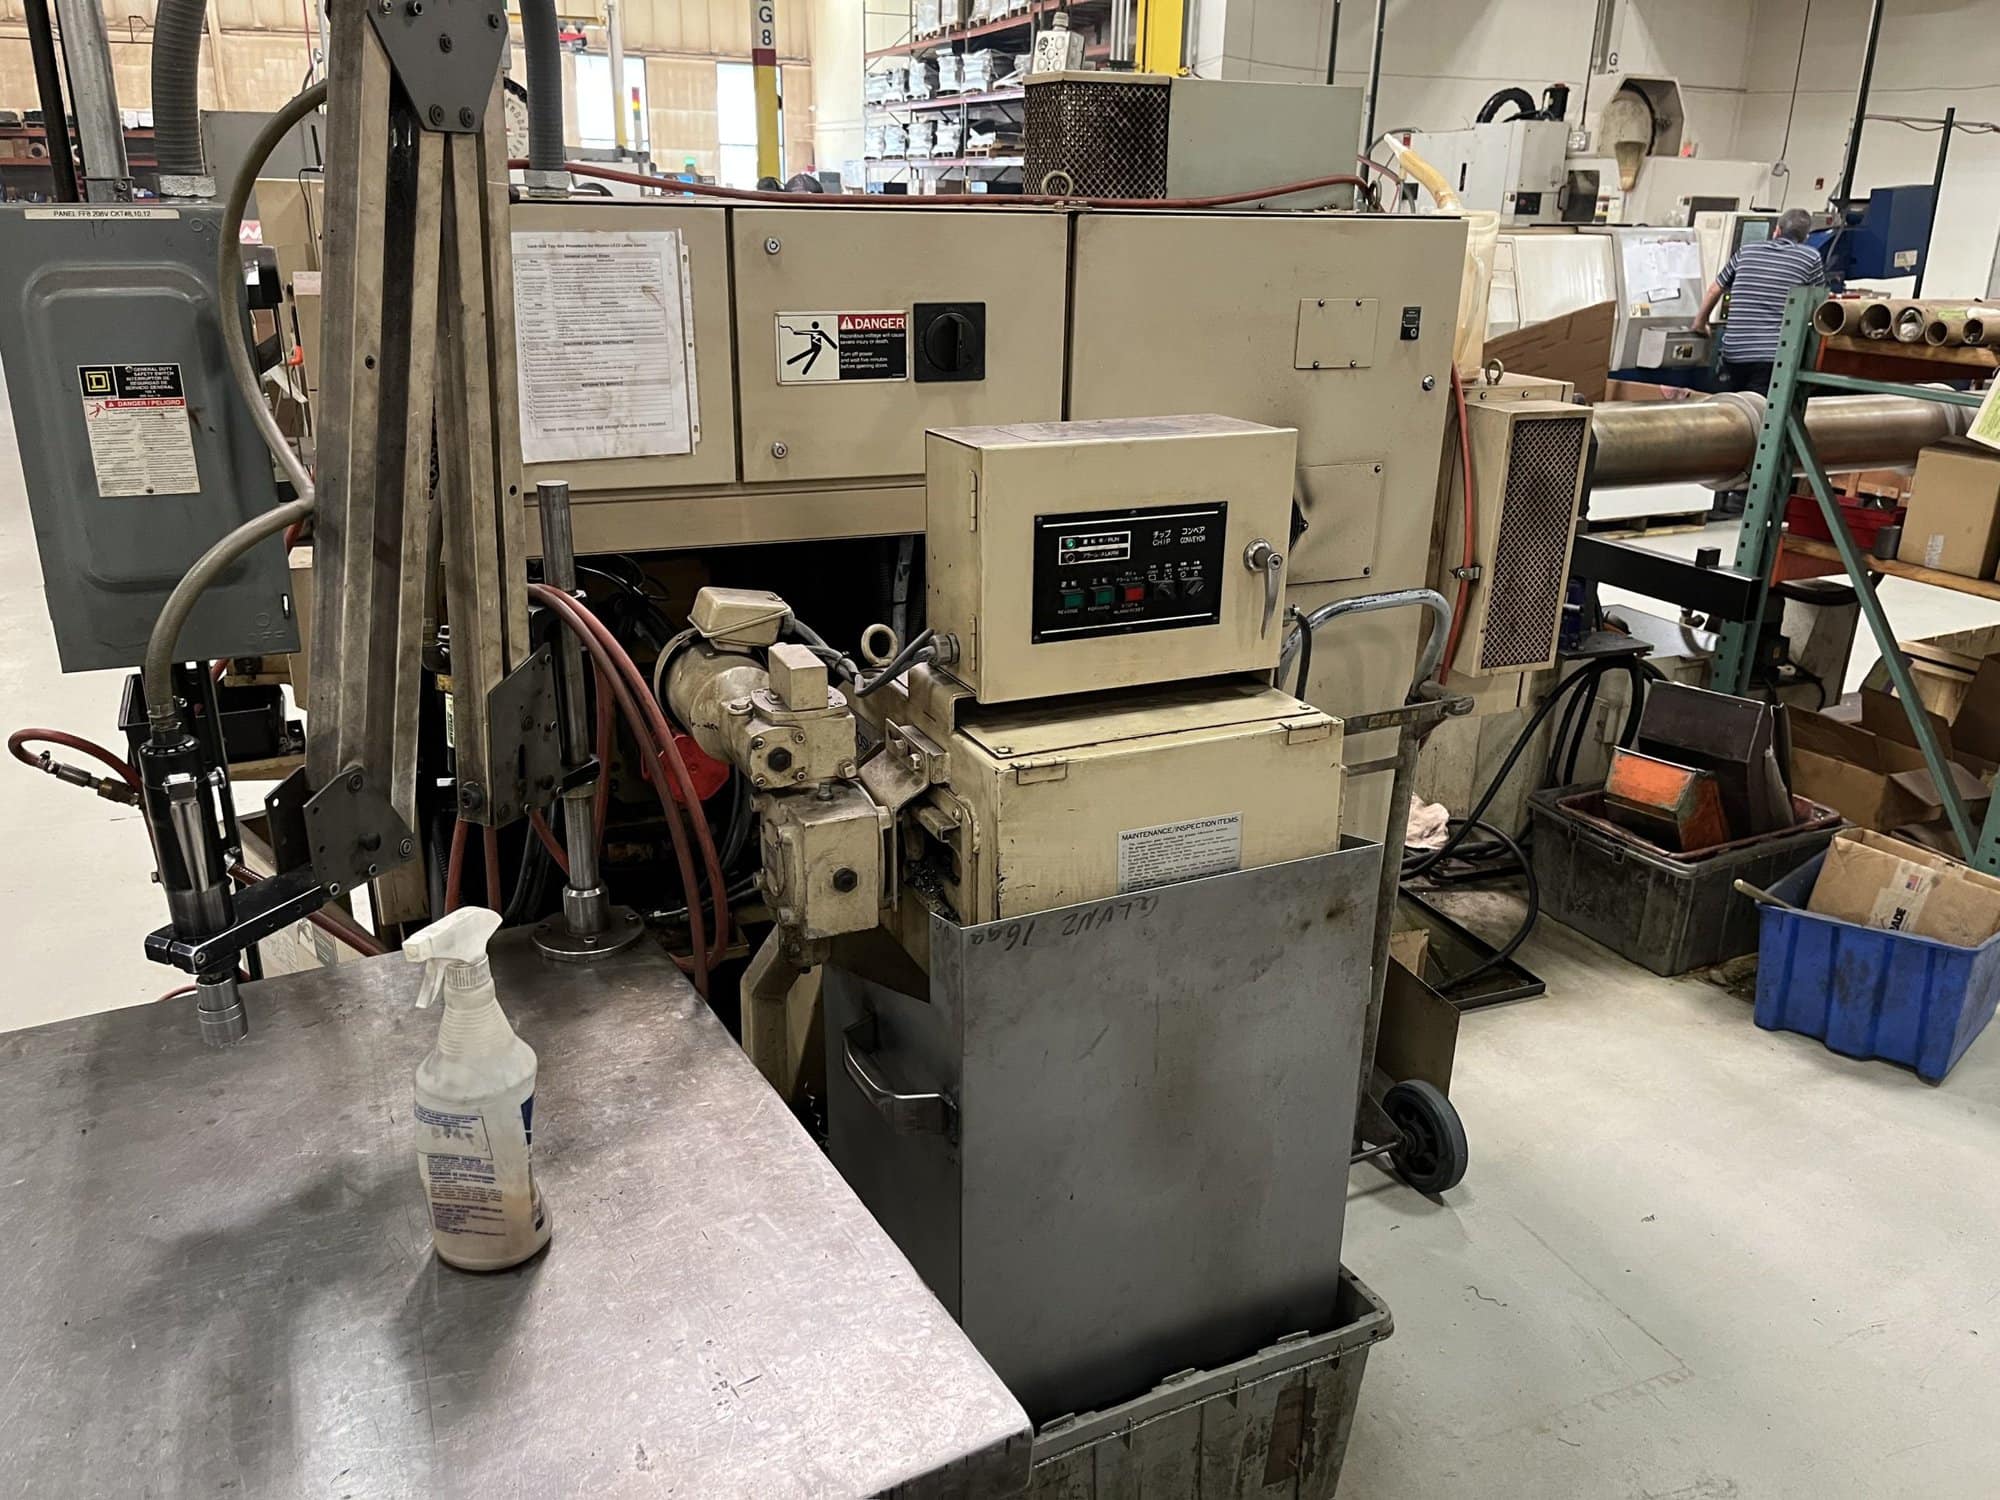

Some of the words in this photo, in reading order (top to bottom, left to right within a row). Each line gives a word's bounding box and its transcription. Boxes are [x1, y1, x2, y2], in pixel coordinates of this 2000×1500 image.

[854, 317, 905, 330] DANGER
[1152, 529, 1172, 539] チップ
[1152, 537, 1172, 547] CHIP
[1179, 535, 1206, 545] CONVEYOR
[1216, 816, 1240, 825] ITEMS
